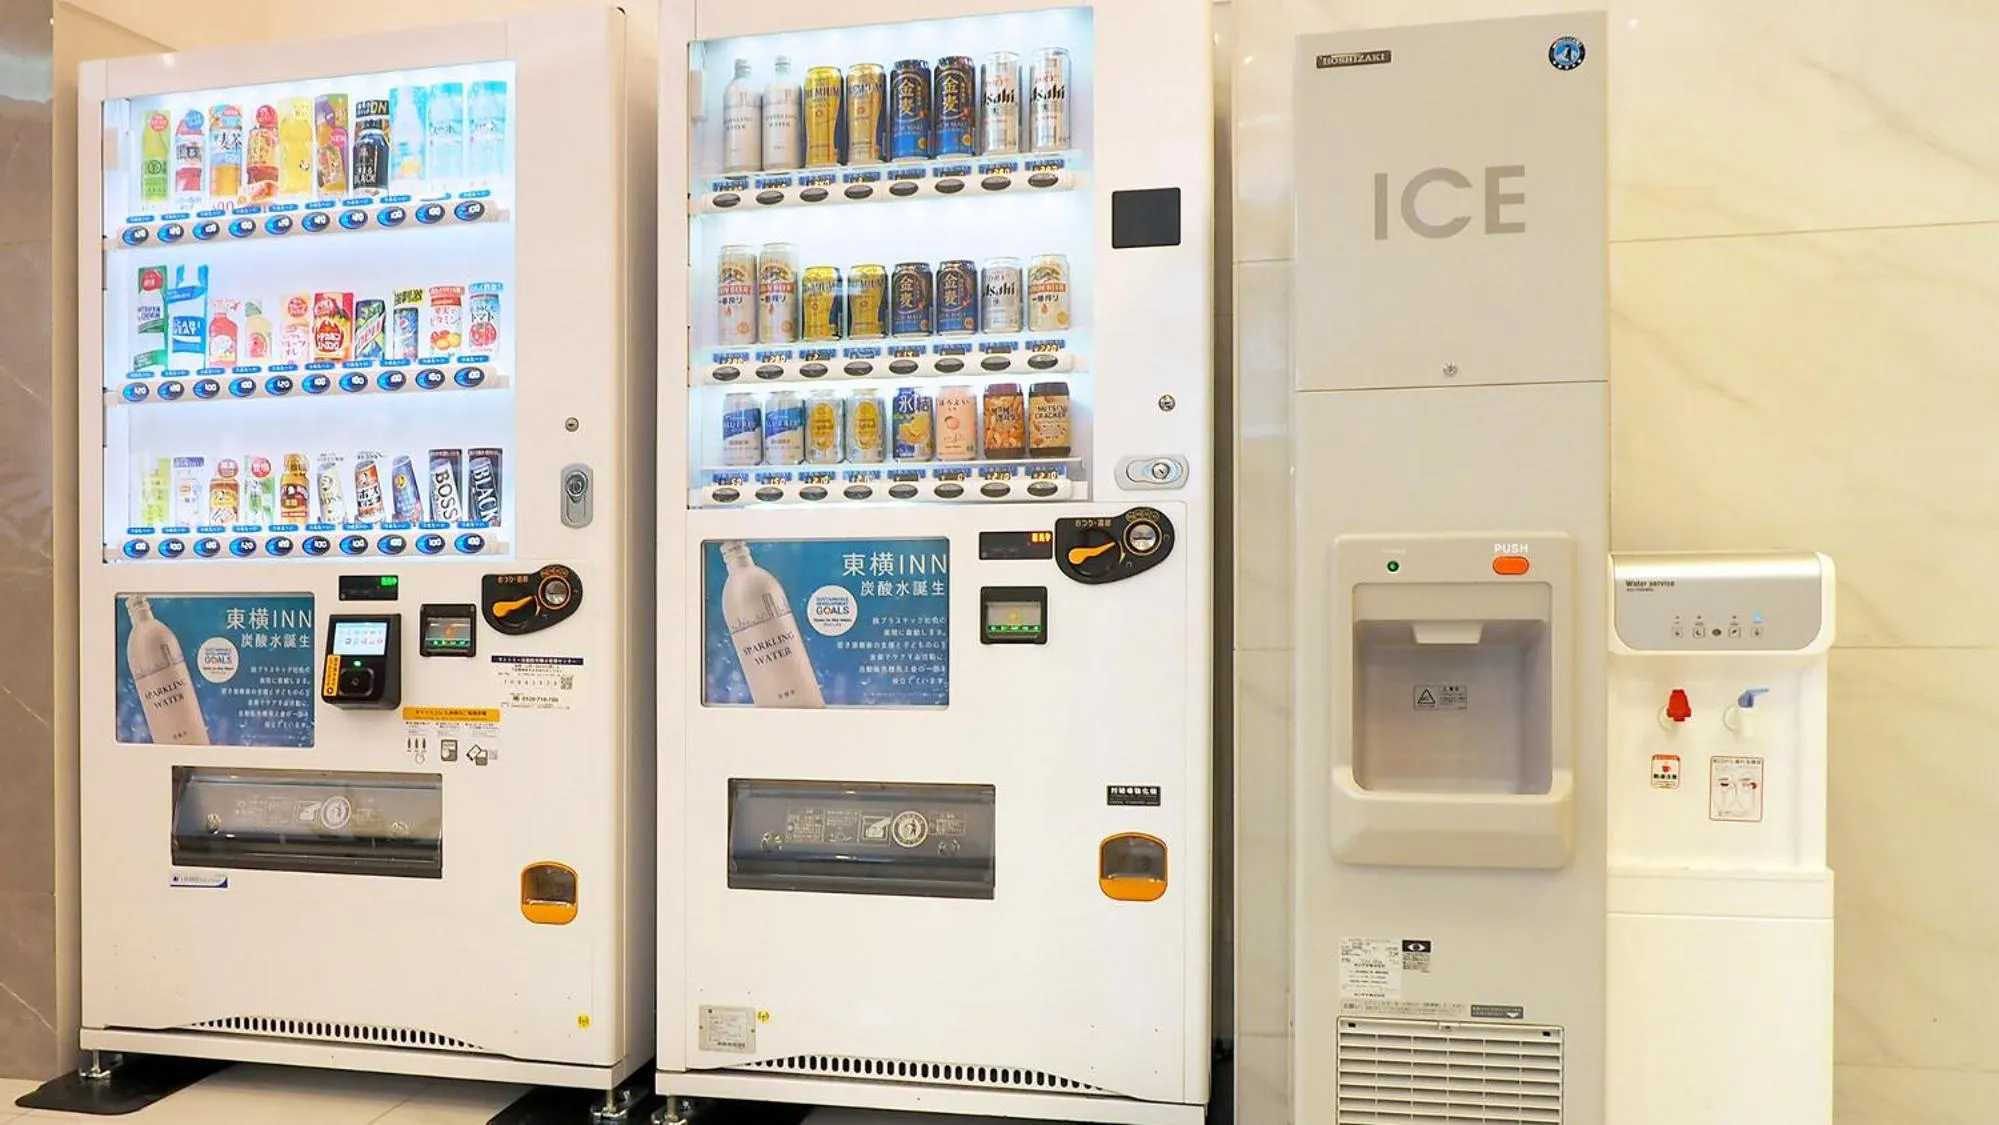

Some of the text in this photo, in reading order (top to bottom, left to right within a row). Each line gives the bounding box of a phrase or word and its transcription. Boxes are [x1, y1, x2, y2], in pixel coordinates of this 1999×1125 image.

[1322, 53, 1386, 66] HOSHIZAKI
[898, 79, 914, 116] 金麦
[942, 76, 958, 114] 金麦
[982, 88, 1015, 106] Asahi
[1029, 84, 1065, 104] Asahi
[1374, 165, 1526, 240] ICE
[900, 276, 913, 308] 金麦
[944, 274, 958, 306] 金麦
[981, 282, 1016, 297] Asahi
[898, 396, 930, 413] 氷結
[435, 469, 458, 523] BOSS
[474, 464, 499, 523] BLACK
[1493, 543, 1530, 554] PUSH
[842, 552, 947, 576] 東横INN
[861, 581, 945, 596] 炭酸水誕生
[1625, 580, 1675, 588] Water service
[226, 607, 312, 630] 東横INN
[816, 606, 850, 615] GOALS
[241, 634, 311, 648] 炭酸水誕生
[743, 631, 795, 656] SPARKLING
[754, 647, 792, 665] WATER
[154, 693, 184, 708] WATER
